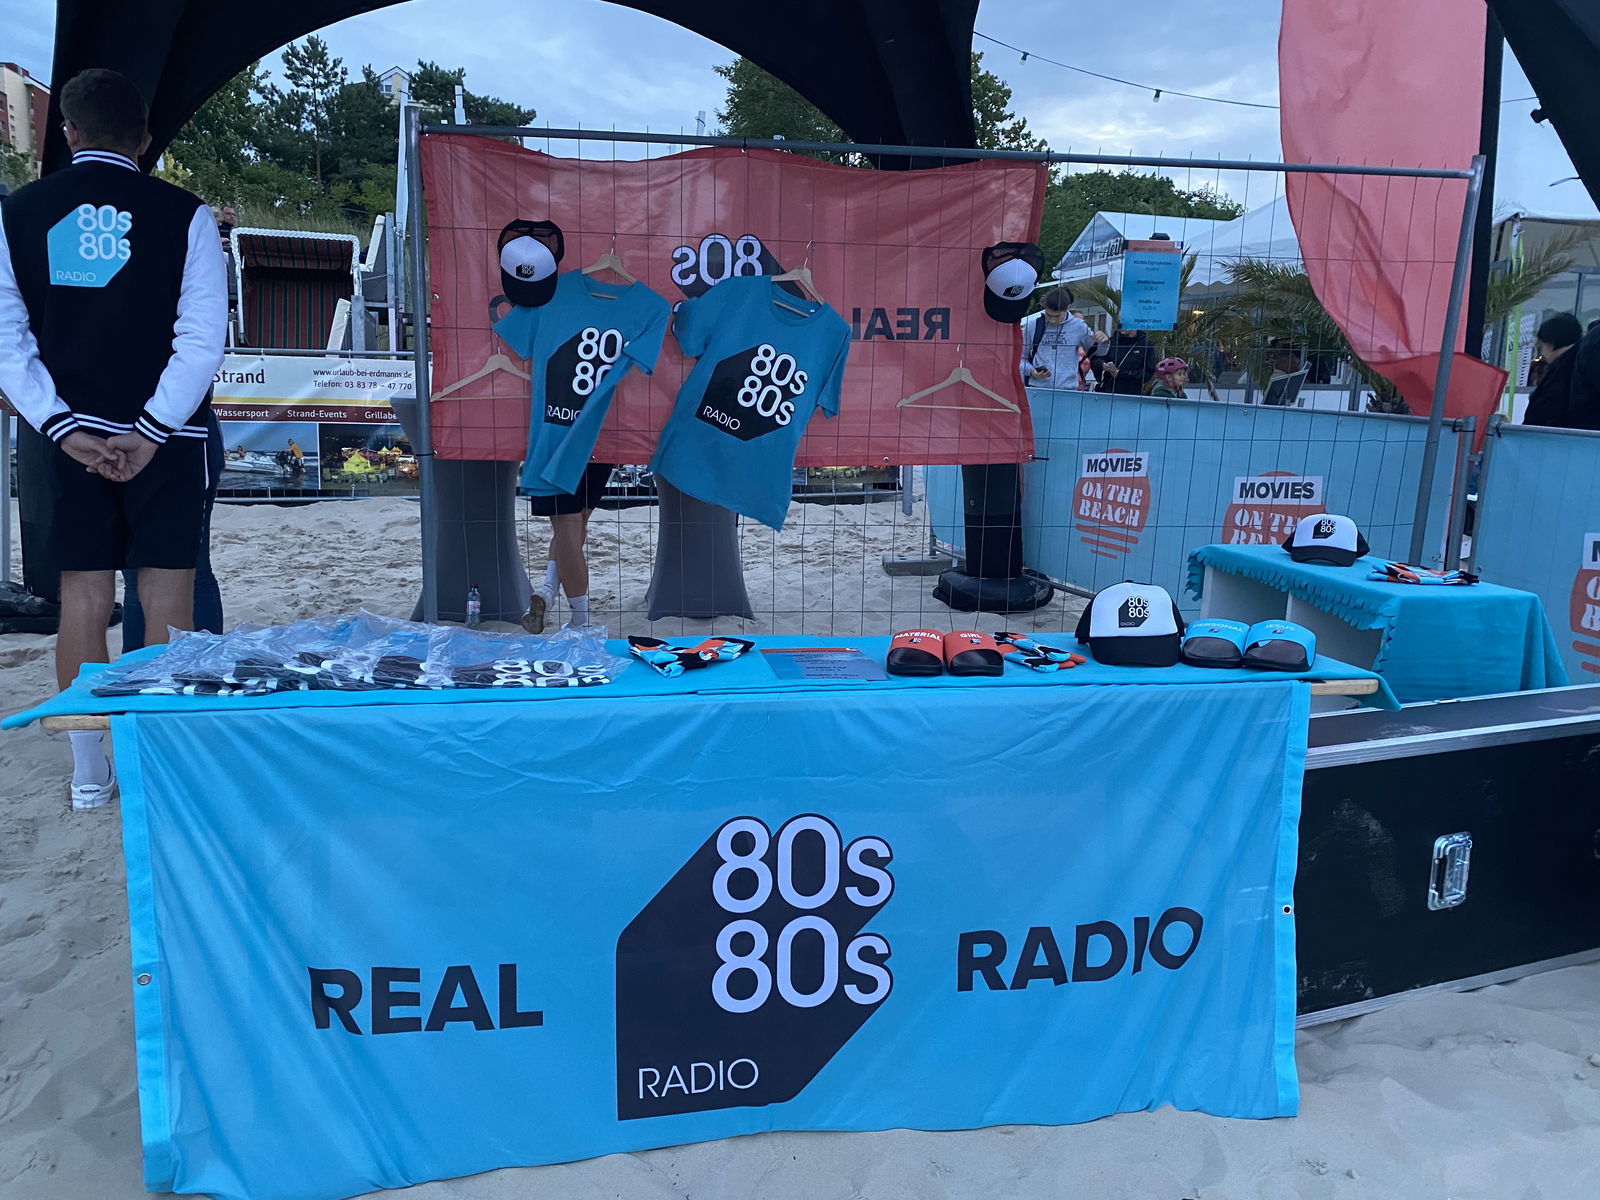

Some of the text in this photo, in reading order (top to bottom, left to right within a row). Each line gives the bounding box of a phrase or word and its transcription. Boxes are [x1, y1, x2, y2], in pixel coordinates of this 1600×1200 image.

[77, 203, 132, 231] 80s
[79, 232, 131, 260] 80s
[56, 270, 96, 283] RADIO
[577, 327, 624, 364] 80
[750, 343, 808, 395] 80s
[314, 380, 342, 388] Telefon:
[344, 381, 354, 389] 03
[356, 381, 366, 389] 83
[368, 381, 378, 389] 78
[387, 382, 396, 390] 47
[214, 408, 269, 418] Wassersport
[287, 409, 347, 418] Strand-Events
[737, 375, 795, 426] 80s
[703, 405, 741, 430] RADIO
[1086, 457, 1143, 473] MOVIES
[1082, 481, 1143, 506] ON THE
[1239, 482, 1315, 499] MOVIES
[1079, 498, 1140, 527] BEACH
[1234, 508, 1301, 535] ON TH
[1128, 596, 1149, 607] 80s
[1128, 607, 1150, 618] 80s
[894, 631, 942, 642] MATERIAL
[1193, 623, 1243, 633] PERSONAL
[712, 816, 893, 914] 80s
[957, 906, 1204, 993] RADIO
[711, 915, 892, 1014] 80s
[307, 963, 544, 1036] REAL
[638, 1058, 759, 1100] RADIO
